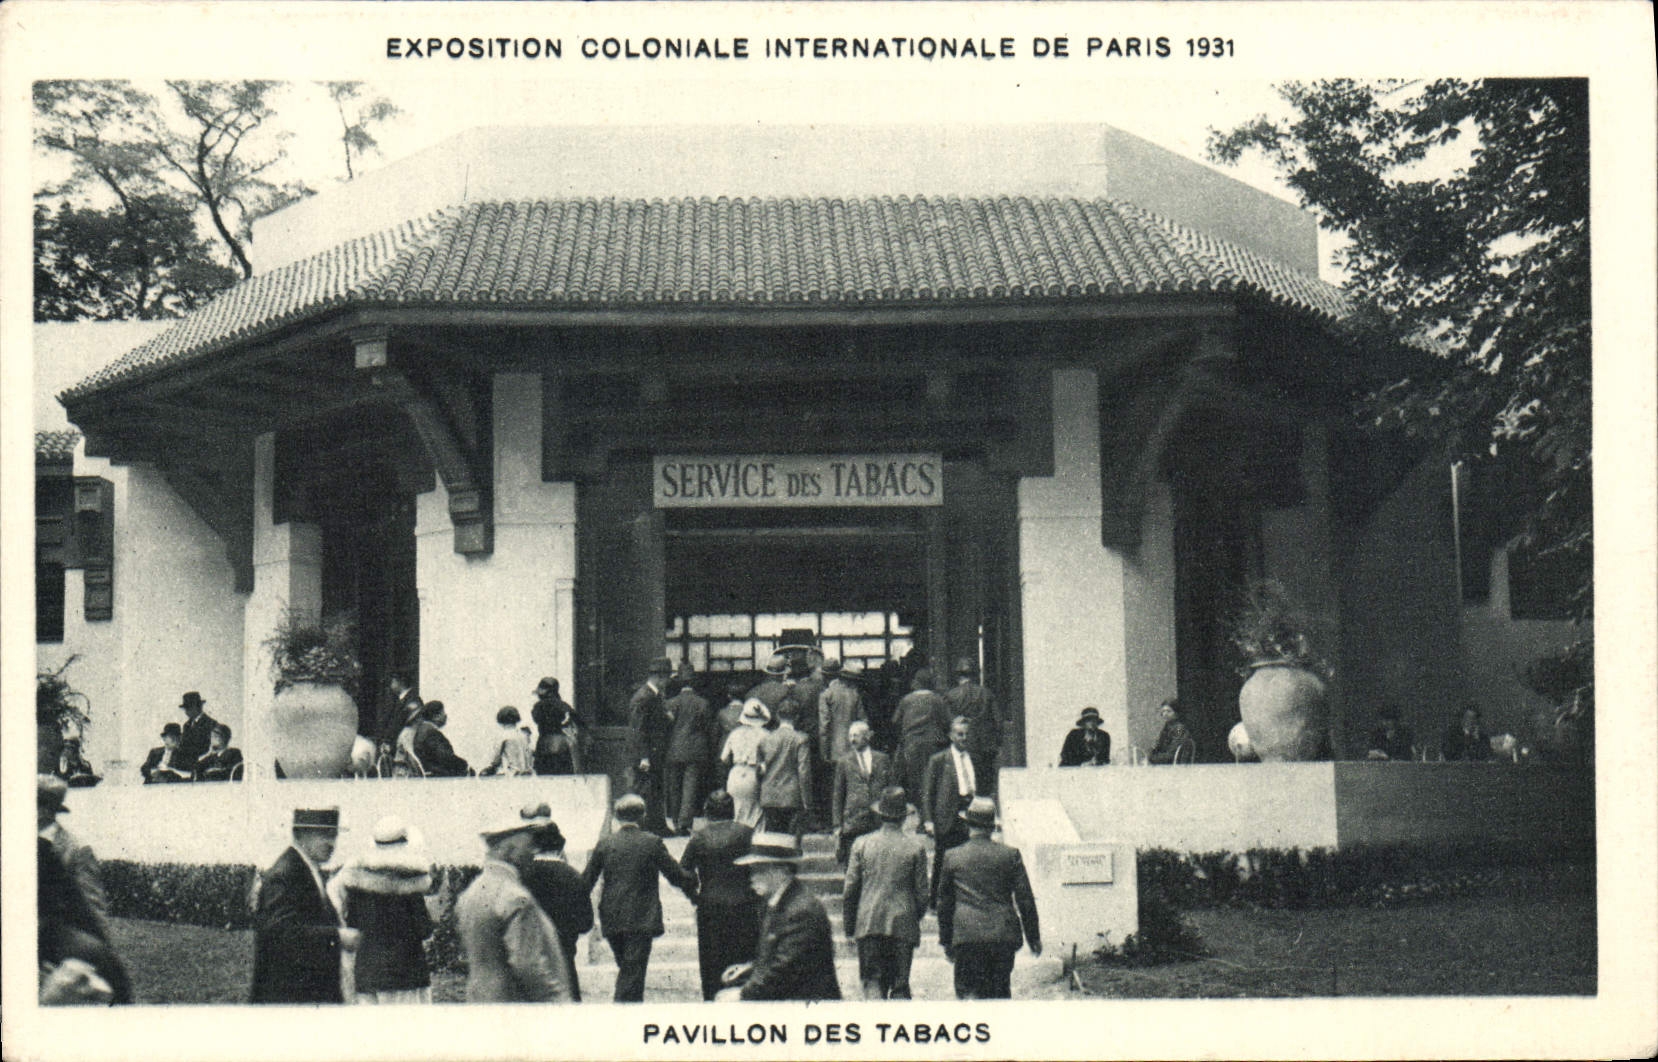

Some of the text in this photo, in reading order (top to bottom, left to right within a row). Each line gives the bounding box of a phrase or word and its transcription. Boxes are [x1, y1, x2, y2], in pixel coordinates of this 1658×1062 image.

[661, 461, 935, 498] SERVICE DES TABACS
